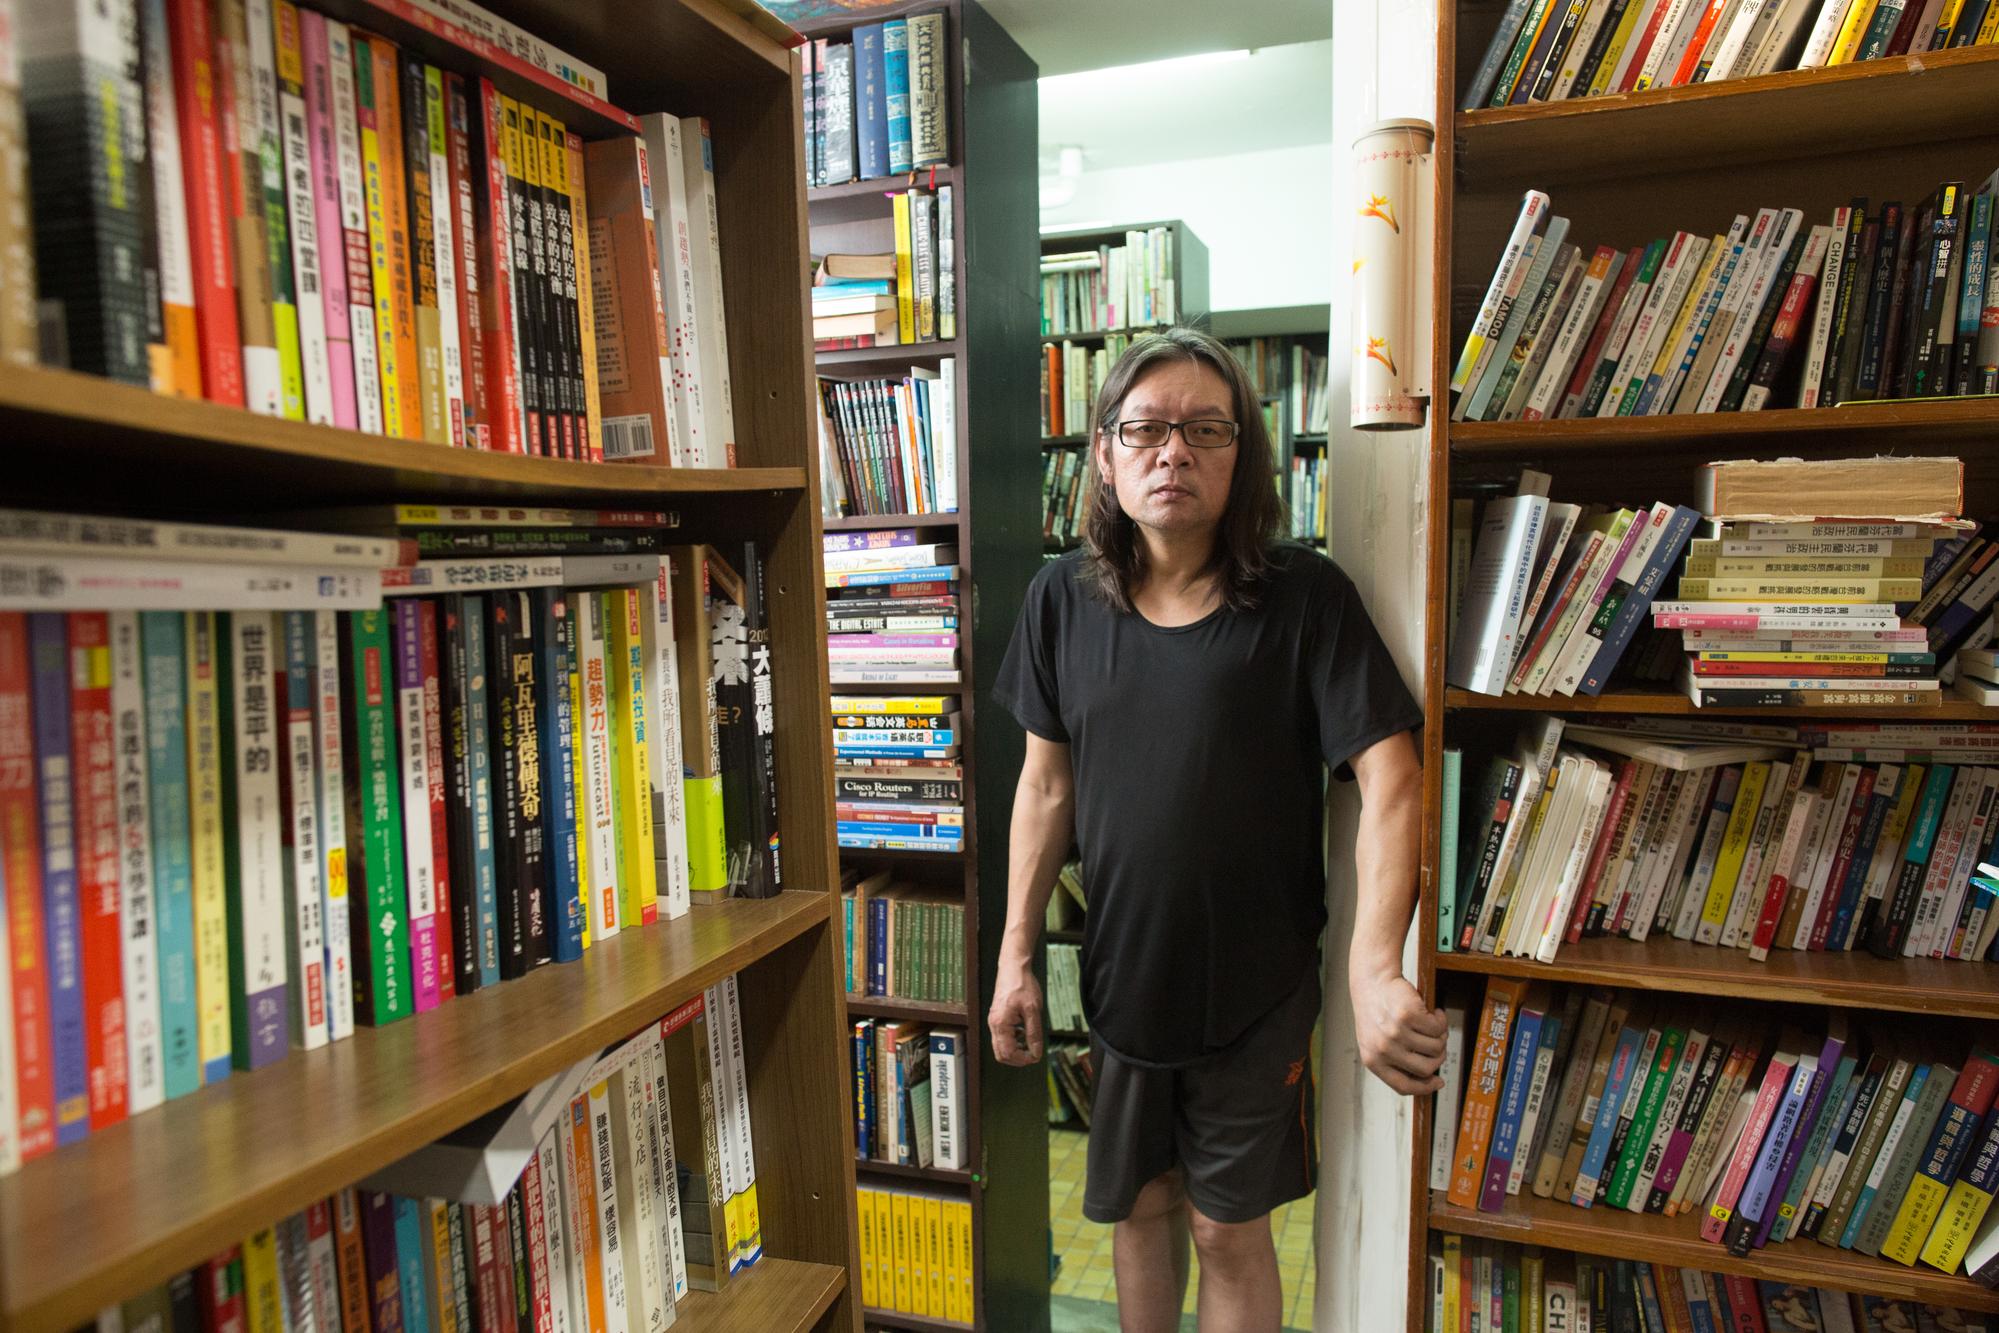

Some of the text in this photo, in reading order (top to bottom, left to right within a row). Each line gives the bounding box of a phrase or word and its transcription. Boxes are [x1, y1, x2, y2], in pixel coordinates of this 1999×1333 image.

[545, 202, 563, 296] 致命的均衡
[559, 208, 577, 300] 致命的均衡
[1824, 240, 1842, 288] CHANGE
[1935, 239, 1951, 278] 心智拼圖
[1967, 240, 1985, 297] 靈性的成長
[653, 269, 665, 314] EMBA
[240, 624, 272, 773] 世界是平的
[752, 645, 774, 736] 大蕭條
[589, 735, 605, 818] Futurecast
[844, 781, 913, 793] Cisco Routers
[936, 1059, 949, 1099] Chesapeake
[1479, 1001, 1512, 1095] 變態心理學
[1528, 1053, 1550, 1113] 心理治療實務
[628, 1078, 648, 1168] 流行る店
[656, 1075, 678, 1219] 做自己與別人生命中的天使
[701, 1082, 723, 1208] 我所看見的未來
[940, 1105, 950, 1132] MICHENER
[940, 1140, 950, 1160] JAMES
[1927, 1105, 1965, 1176] 邏輯與哲學
[1970, 1120, 1999, 1184] 輯與哲學
